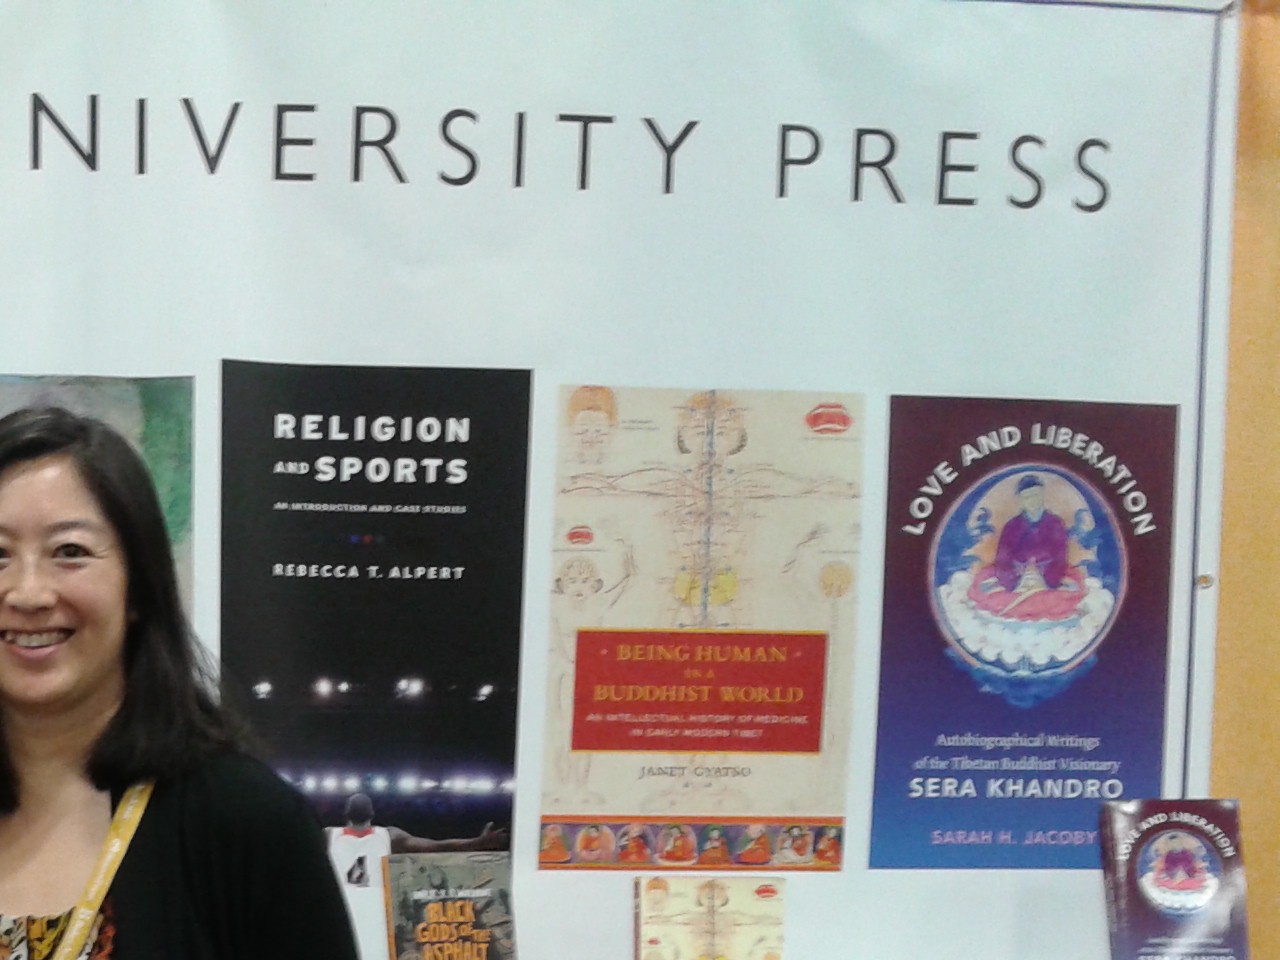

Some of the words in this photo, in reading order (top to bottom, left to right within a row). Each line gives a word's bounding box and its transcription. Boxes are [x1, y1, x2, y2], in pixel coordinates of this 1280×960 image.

[777, 123, 1113, 213] PRESS
[273, 413, 470, 443] RELIGION
[273, 461, 310, 475] AND
[314, 456, 468, 484] SPORTS
[902, 461, 959, 535] LOVE
[960, 425, 1022, 466] AND
[1031, 422, 1157, 536] LIBERATION
[289, 503, 368, 512] INTRODUCTION
[369, 505, 392, 513] AND
[272, 563, 360, 578] REBECCA
[366, 566, 383, 578] T.
[388, 565, 466, 579] ALPERT
[616, 644, 690, 661] BEING
[694, 645, 787, 662] HUMAN
[594, 684, 713, 702] BUDDHIST
[720, 686, 804, 703] WORLD
[936, 733, 1044, 750] Autobiographical
[1047, 733, 1100, 751] Writings
[638, 766, 688, 779] JANET
[694, 766, 752, 778] GYATSO
[932, 756, 948, 769] the
[950, 756, 999, 770] Tibetan
[1002, 756, 1057, 770] Buddhist
[1058, 757, 1122, 774] Visionary
[908, 777, 978, 798] SERA
[986, 777, 1124, 799] KHANDRO
[931, 830, 993, 845] SARAH
[999, 831, 1017, 845] H.
[1024, 830, 1098, 845] JACOBY
[1168, 811, 1237, 858] LIBERATION
[425, 900, 476, 923] BLACK
[415, 921, 458, 943] GODS
